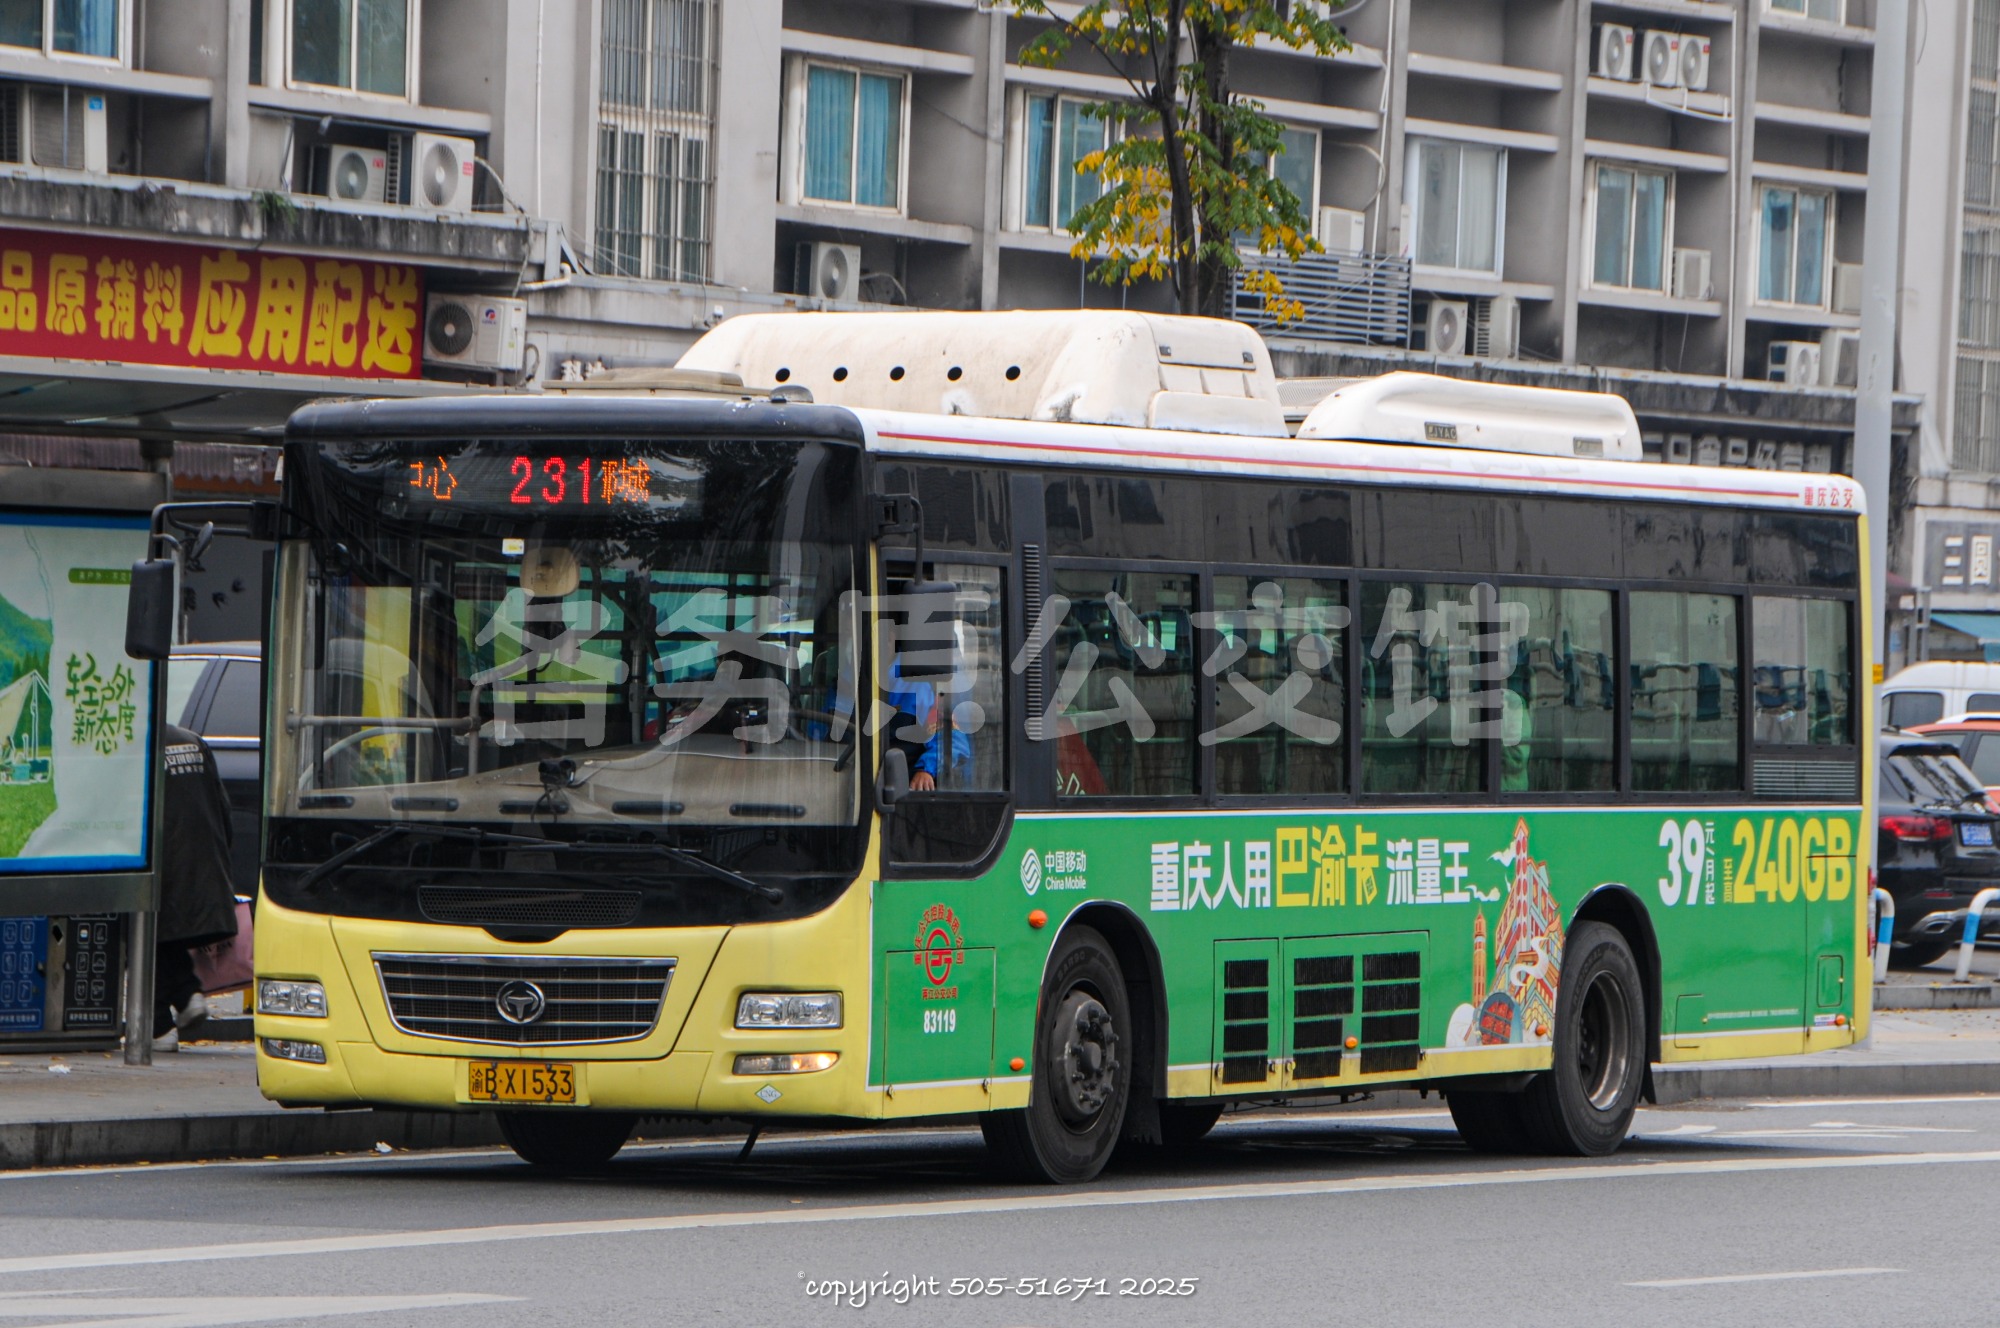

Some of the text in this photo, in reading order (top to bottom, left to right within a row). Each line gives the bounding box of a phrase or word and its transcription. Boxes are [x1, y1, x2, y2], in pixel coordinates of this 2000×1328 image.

[0, 249, 419, 375] 品原辅料应用配送
[511, 456, 592, 503] 231
[1804, 486, 1853, 508] 重庆公交
[1942, 535, 2000, 585] 三圆
[66, 652, 135, 709] 轻户外
[72, 700, 136, 754] 新态度
[1045, 850, 1086, 873] 中国移动
[1045, 875, 1086, 890] China Mobile
[1150, 824, 1470, 911] 重庆人用巴渝卡流量王
[1658, 819, 1705, 906] 39
[1732, 818, 1851, 903] 240GB
[922, 987, 958, 1000] 两江公交公司
[924, 1008, 956, 1033] 83119
[760, 1089, 777, 1098] CNG
